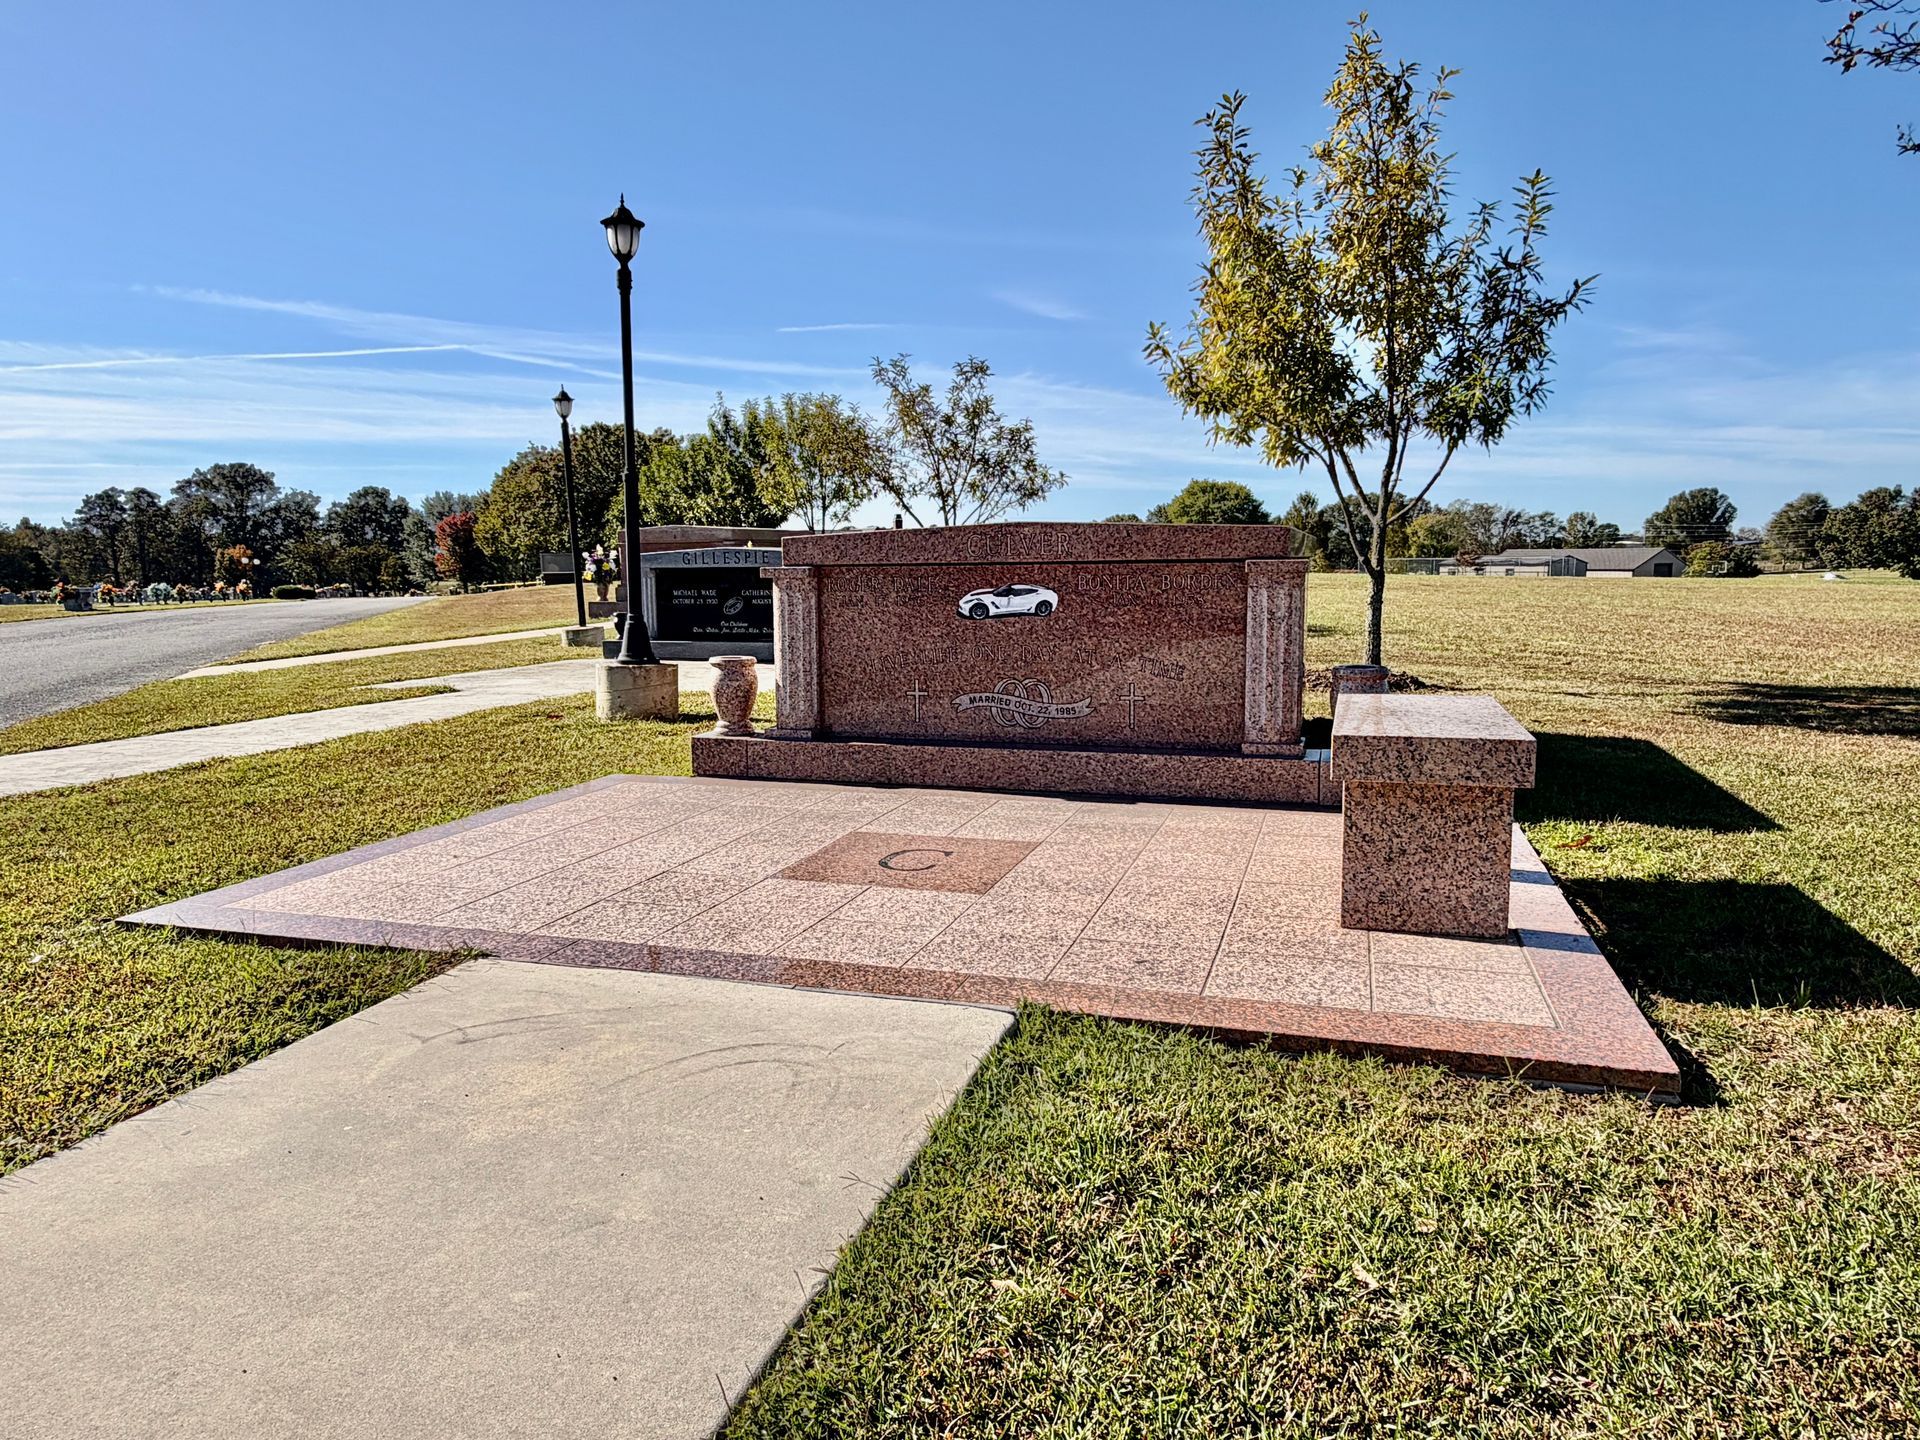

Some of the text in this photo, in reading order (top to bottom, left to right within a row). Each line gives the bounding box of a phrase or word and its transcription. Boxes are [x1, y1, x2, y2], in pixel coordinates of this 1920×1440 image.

[966, 532, 1072, 557] CULVER
[682, 551, 769, 565] GILLESPIE
[827, 575, 880, 593] ROGER
[1077, 574, 1241, 592] BONITA BORDEN
[971, 645, 1006, 661] ONE
[1022, 645, 1058, 662] DAY
[1138, 656, 1186, 682] TIME
[969, 695, 1077, 716] MARRIED OCT. 22, 1985
[878, 849, 953, 872] C
